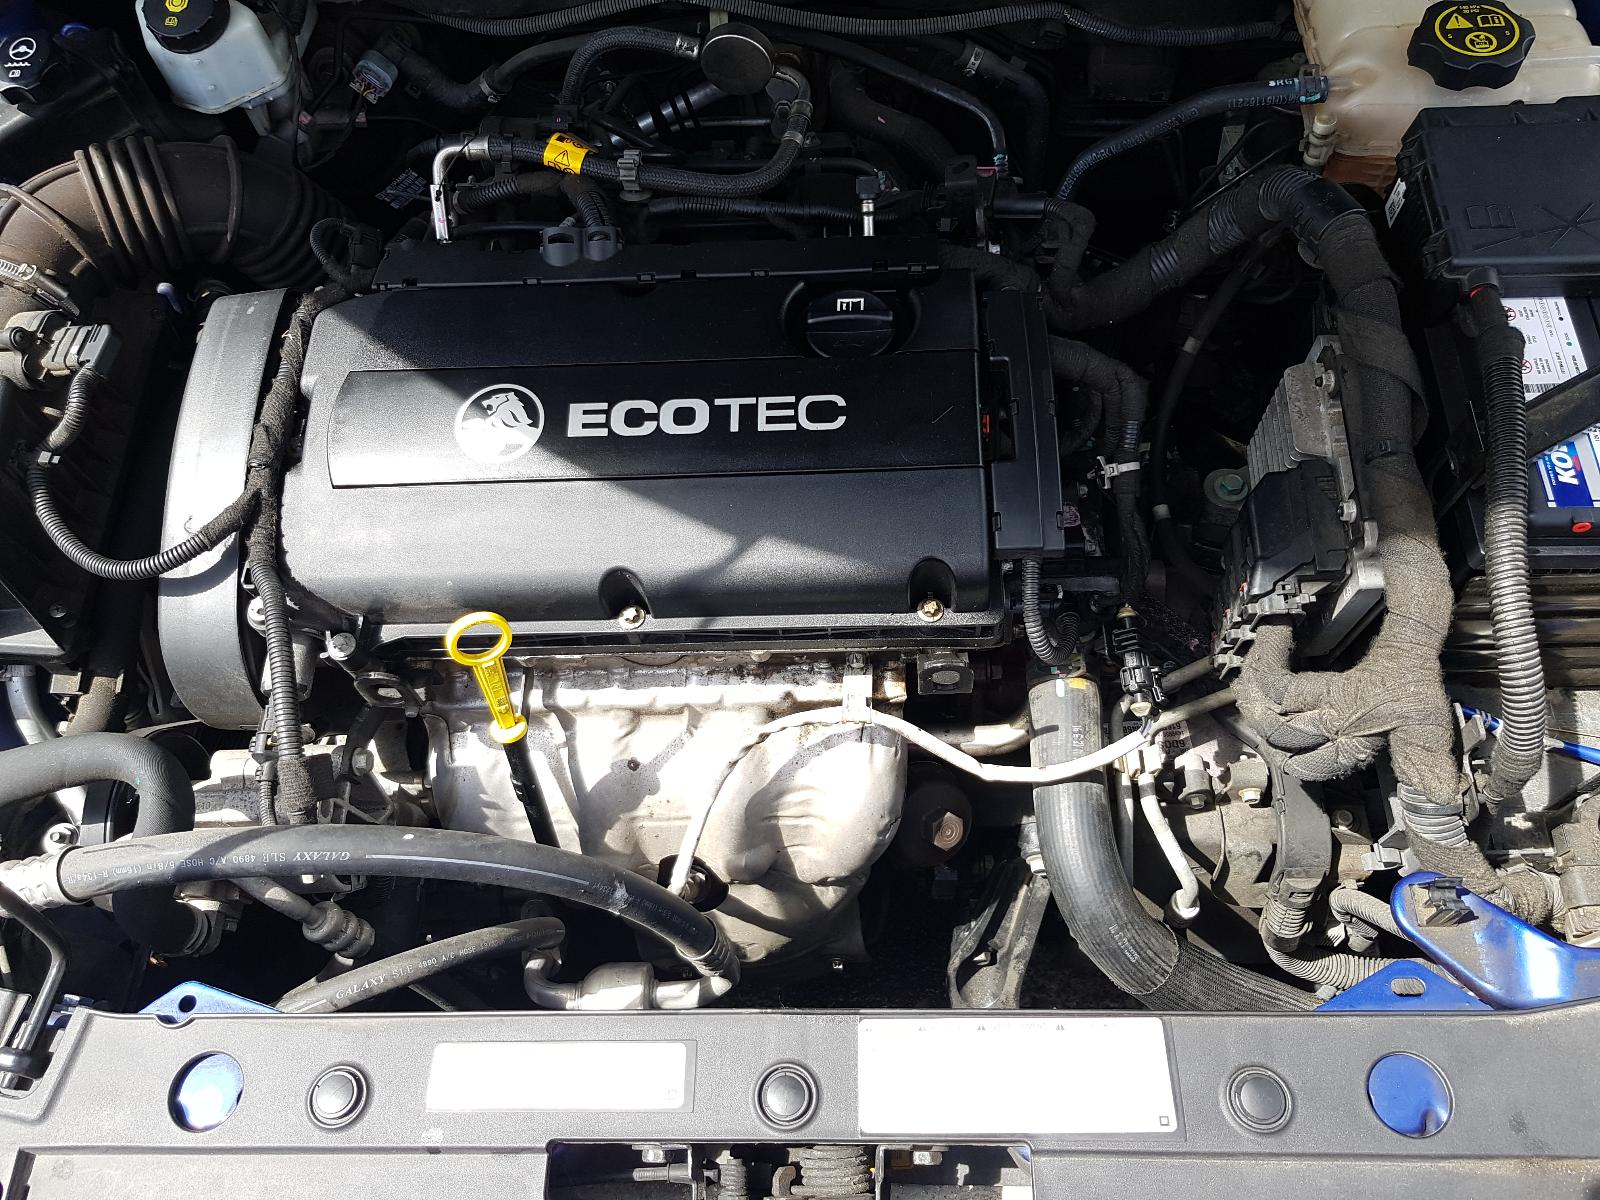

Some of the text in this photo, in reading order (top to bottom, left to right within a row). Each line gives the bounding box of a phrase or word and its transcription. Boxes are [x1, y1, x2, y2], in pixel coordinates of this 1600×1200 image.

[567, 394, 847, 437] ECOTEC
[209, 855, 227, 866] A/C
[232, 854, 256, 864] 4890
[293, 851, 351, 861] GALAXY
[180, 859, 204, 868] HOSE
[335, 974, 386, 1000] GALAXY
[441, 948, 455, 961] A/C
[459, 946, 476, 957] HOSE
